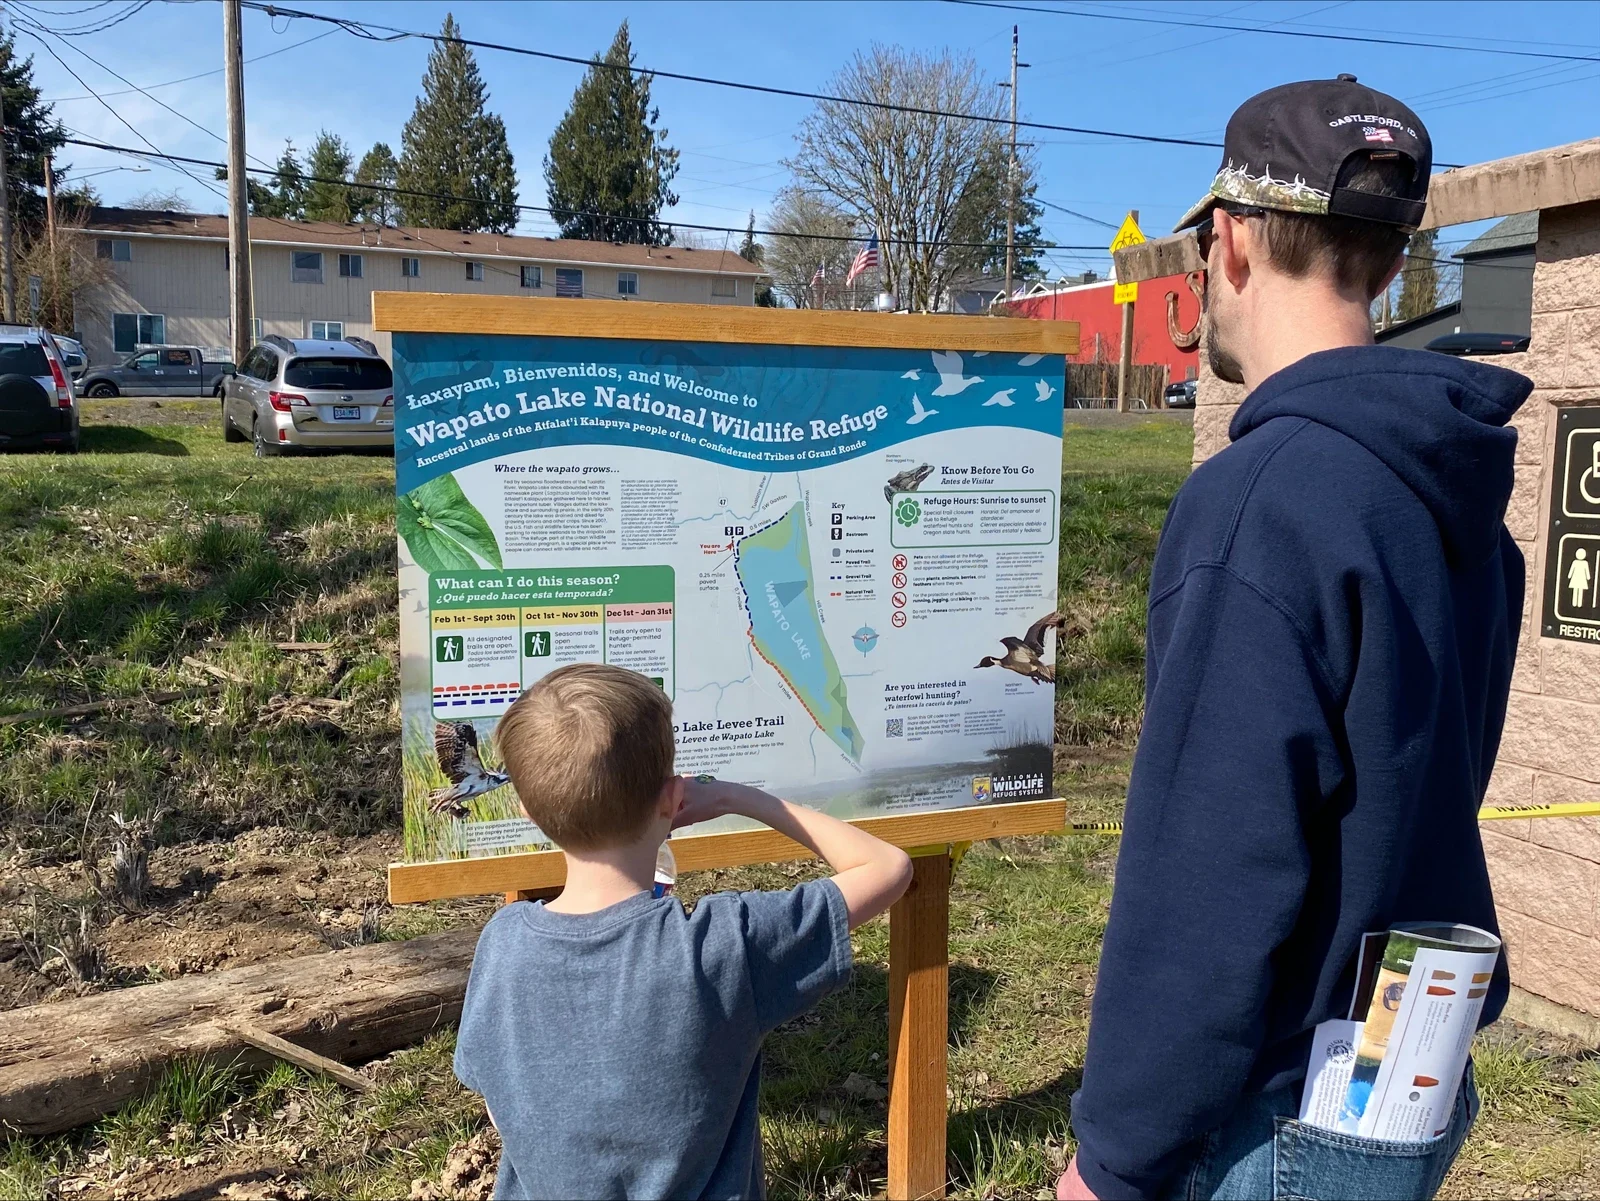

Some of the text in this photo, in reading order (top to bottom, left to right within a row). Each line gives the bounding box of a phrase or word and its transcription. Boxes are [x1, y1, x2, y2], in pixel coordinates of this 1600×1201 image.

[1329, 114, 1403, 131] CASTLEFORD,
[503, 363, 622, 384] Bienvenidos,
[628, 370, 660, 386] and
[663, 373, 739, 405] Welcome
[743, 394, 758, 408] to
[406, 386, 888, 448] Wapato Lake National Wildlife Refuge
[416, 441, 469, 468] Ancestral
[470, 431, 500, 448] lands
[502, 426, 513, 438] of
[514, 423, 532, 436] the
[580, 417, 631, 431] Kalapuya
[633, 422, 667, 436] people
[669, 430, 681, 439] of
[681, 429, 697, 444] the
[698, 437, 763, 460] Confederated
[763, 452, 795, 462] Tribes
[796, 450, 807, 460] of
[807, 448, 838, 459] Grand
[838, 439, 867, 455] Ronde
[494, 464, 526, 473] Where
[528, 464, 544, 473] the
[546, 465, 581, 475] wapato
[941, 466, 1035, 475] Know Before You Go
[831, 502, 846, 510] Key
[923, 497, 952, 507] Refuge
[953, 497, 979, 505] Hours:
[980, 496, 1009, 505] Sunrise
[1020, 496, 1047, 504] sunset
[435, 573, 620, 590] What can I do this season?
[435, 588, 614, 604] ¿Qué puedo hacer esta temporada?
[525, 612, 541, 620] Oct
[580, 610, 599, 618] 30th
[640, 608, 656, 616] Jan
[453, 615, 466, 623] 1st
[473, 614, 493, 624] Sept
[495, 613, 516, 621] 30th
[764, 580, 811, 661] WAPATO LAKE
[625, 628, 638, 636] only
[475, 635, 513, 644] designated
[885, 680, 967, 693] Are you interested in
[884, 690, 961, 702] waterfowl hunting?
[896, 702, 918, 710] interesa
[682, 721, 714, 732] Lake
[716, 719, 753, 730] Levee
[754, 715, 785, 727] Trail
[682, 736, 708, 744] Levee
[709, 733, 720, 742] de
[721, 732, 753, 742] Wapato
[754, 730, 775, 738] Lake
[993, 772, 1044, 782] NATIONAL
[993, 778, 1044, 792] WILDLIFE
[992, 788, 1044, 799] REFUGE SYSTEM
